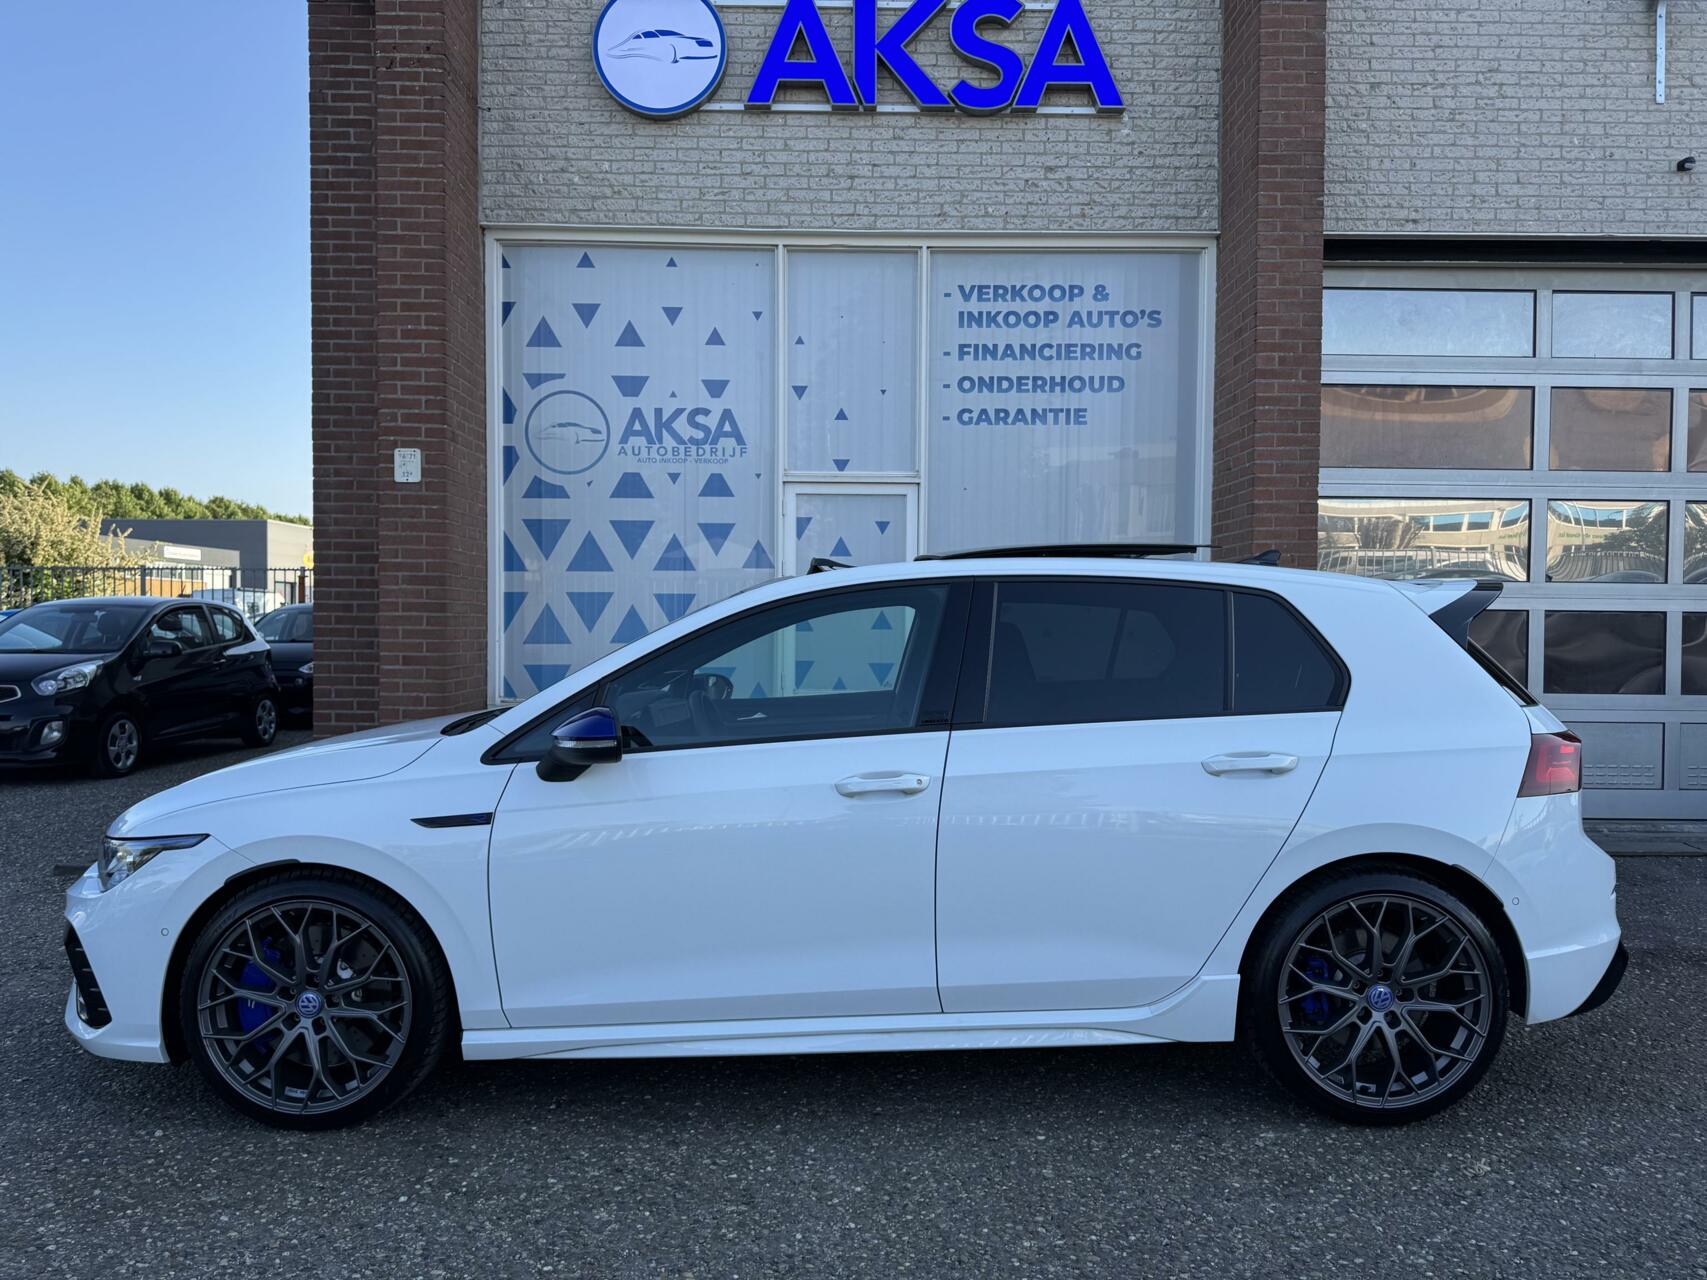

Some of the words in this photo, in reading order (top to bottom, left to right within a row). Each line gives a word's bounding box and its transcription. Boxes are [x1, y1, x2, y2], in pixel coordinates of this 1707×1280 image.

[745, 0, 1126, 115] AKSA
[957, 284, 1085, 303] VERKOOP
[1092, 284, 1110, 303] &
[957, 310, 1060, 329] INKOOP
[957, 343, 1143, 362] FINANCIERING
[956, 375, 1126, 394] ONDERHOUD
[956, 407, 1088, 426] GARANTIE
[618, 407, 747, 446] AKSA
[617, 445, 748, 458] AUTOBEDRIJF
[659, 457, 689, 465] INKOOP
[694, 457, 729, 465] VERKOOP
